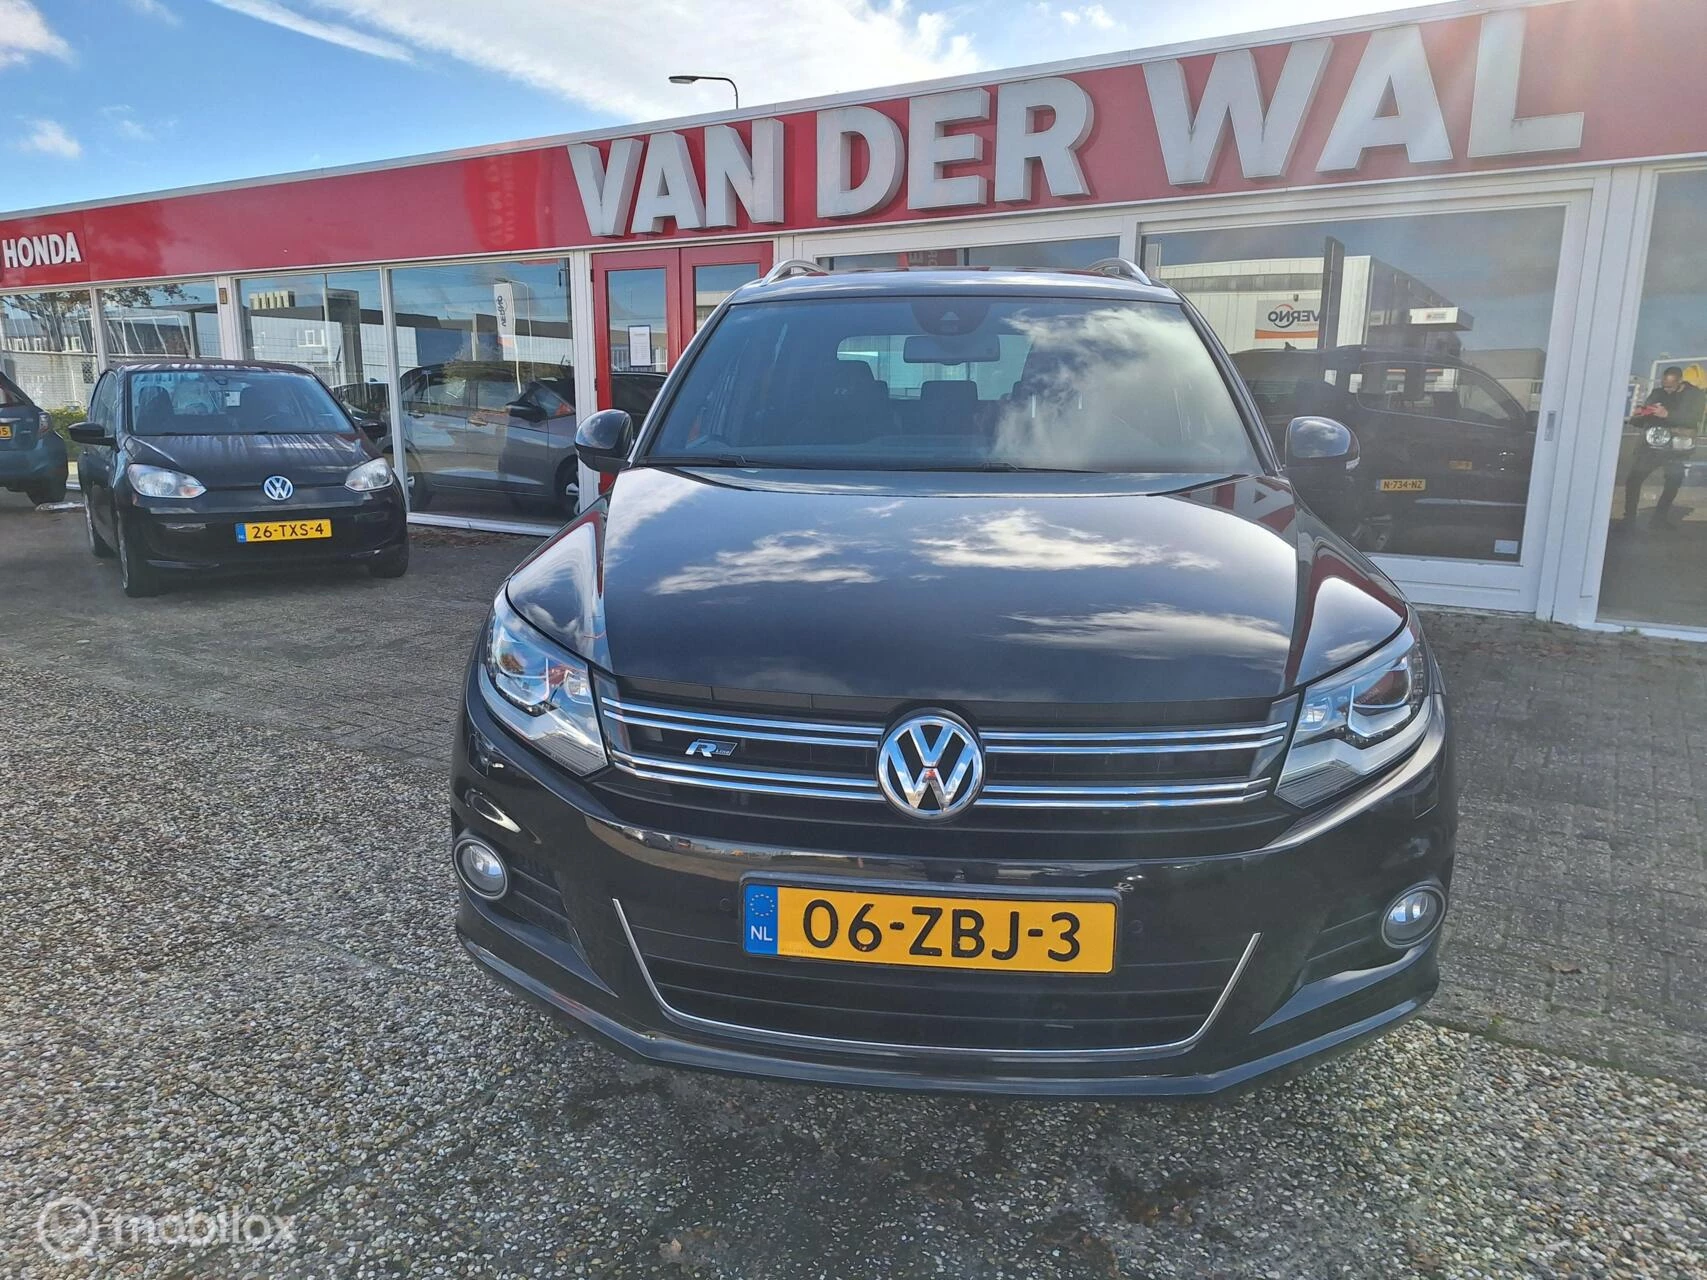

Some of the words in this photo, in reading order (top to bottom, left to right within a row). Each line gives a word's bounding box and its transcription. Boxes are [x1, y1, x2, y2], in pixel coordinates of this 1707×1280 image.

[567, 118, 784, 237] VAN
[816, 77, 1094, 219] DER
[1143, 10, 1584, 185] WAL
[2, 232, 81, 268] HONDA
[1383, 481, 1422, 489] N-734-NZ
[252, 523, 324, 539] 26-TXS-4
[751, 925, 773, 941] NL
[803, 899, 1081, 962] 06-ZBJ-3
